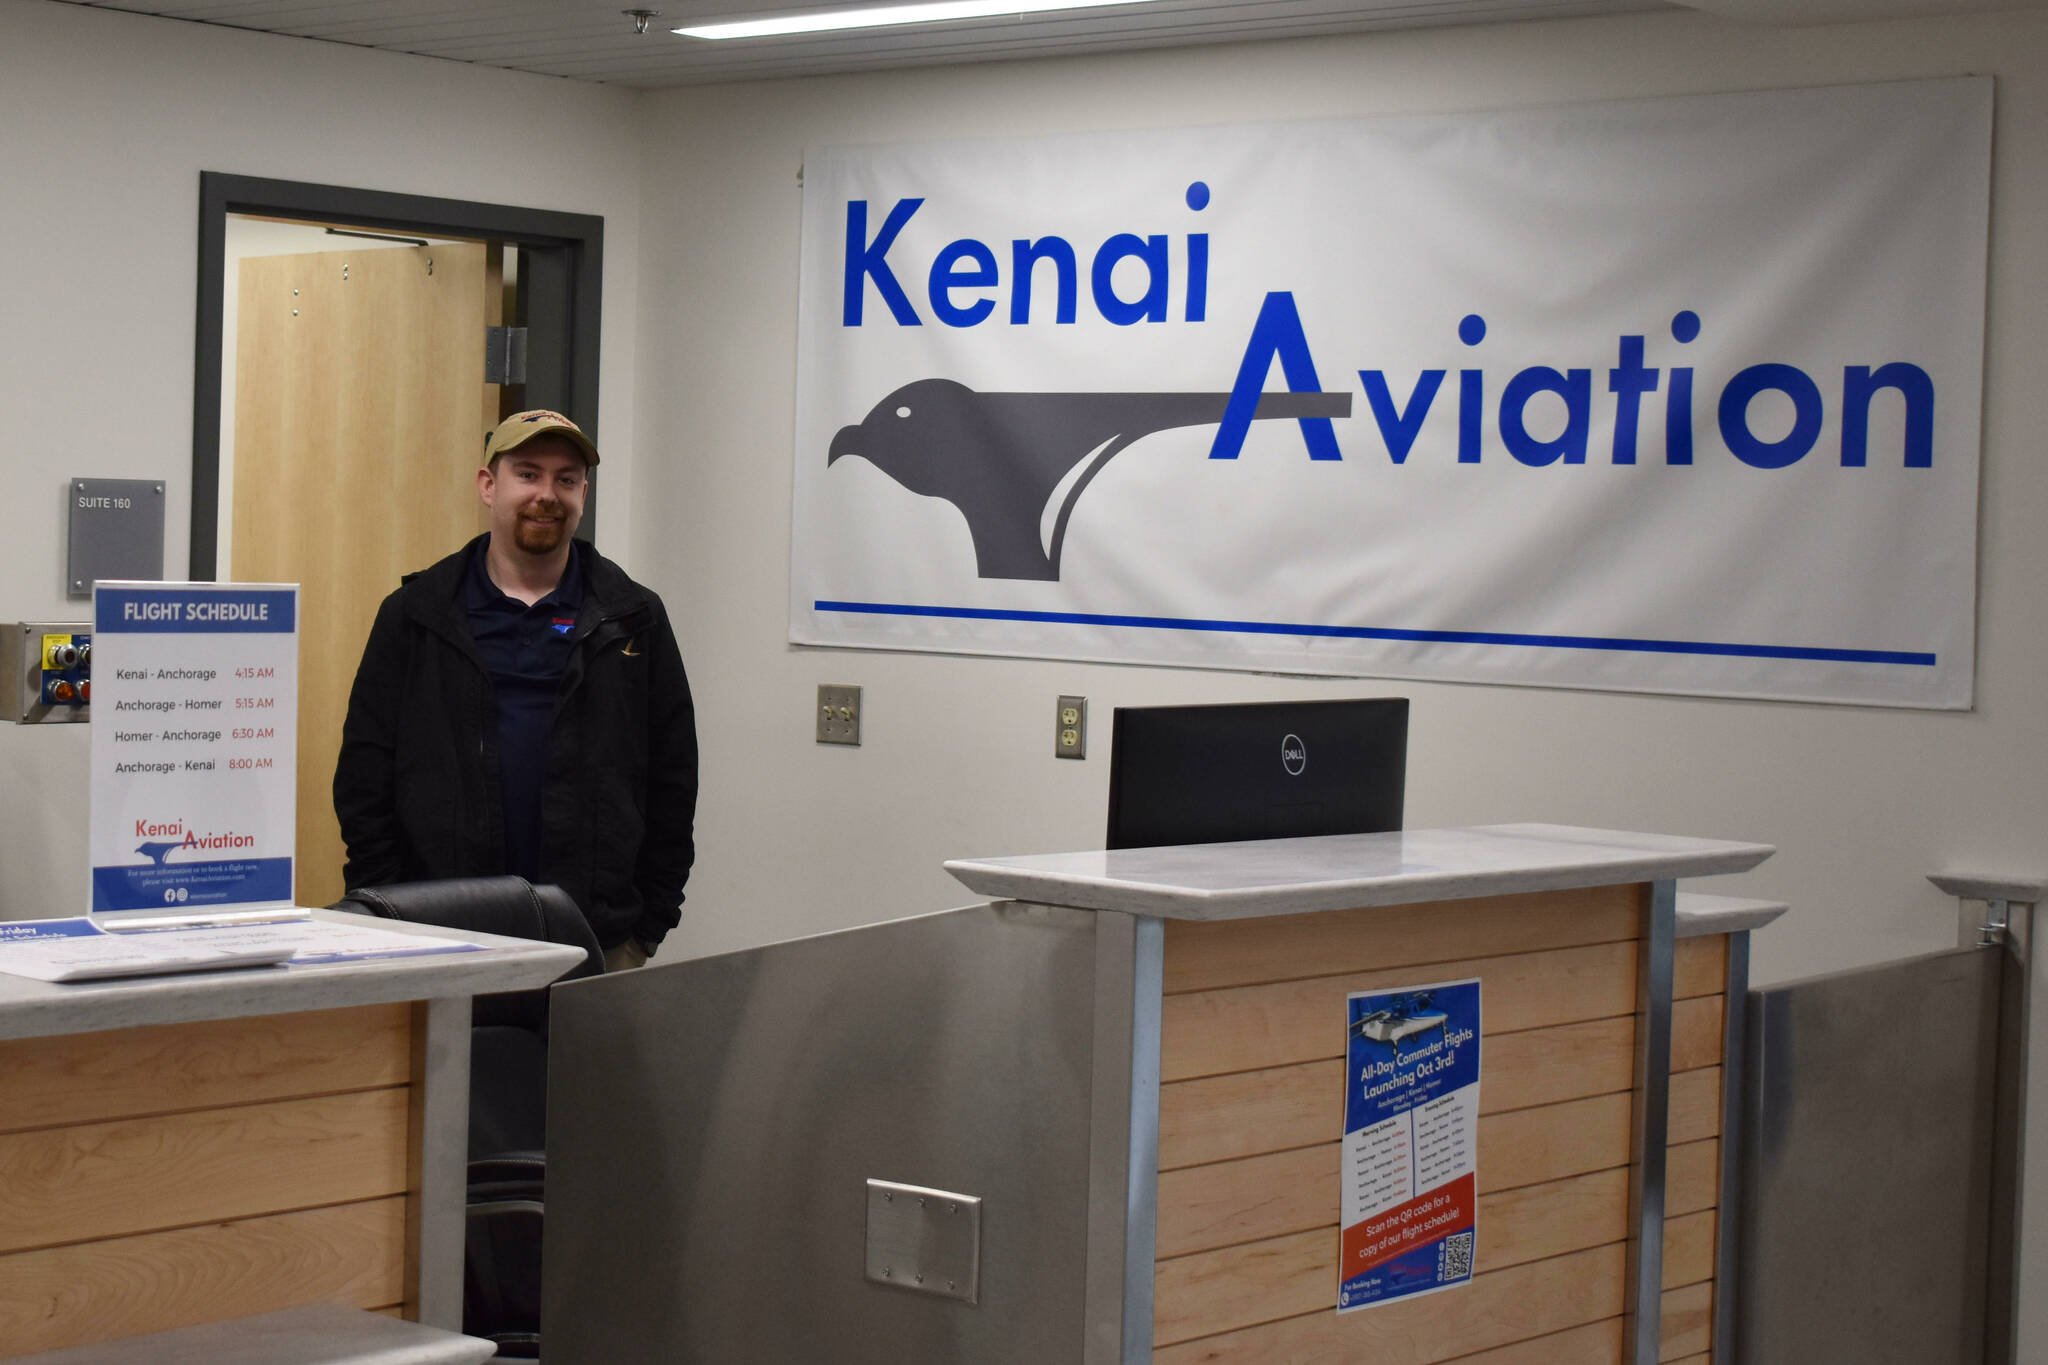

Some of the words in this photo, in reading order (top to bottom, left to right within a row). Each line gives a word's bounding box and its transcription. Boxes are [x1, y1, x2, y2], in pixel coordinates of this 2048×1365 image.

[842, 181, 1210, 328] Kenai
[1208, 291, 1937, 468] Aviation
[78, 497, 110, 509] SUITE
[113, 498, 131, 509] 160
[124, 603, 182, 620] FLIGHT
[185, 603, 268, 621] SCHEDULE
[116, 668, 148, 680] Kenai
[157, 668, 217, 681] Anchorage
[235, 668, 254, 679] 4:15
[257, 667, 274, 678] AM
[115, 700, 176, 712] Anchorage
[185, 699, 222, 709] Homer
[235, 698, 254, 709] 5:15
[257, 698, 274, 708] AM
[115, 731, 153, 741] Homer
[162, 730, 222, 742] Anchorage
[232, 728, 254, 739] 6:30
[256, 728, 274, 738] AM
[1285, 750, 1303, 760] DELL
[115, 762, 175, 774] Anchorage
[185, 759, 215, 771] Kenai
[229, 759, 253, 769] 8:00
[255, 758, 273, 769] AM
[136, 818, 183, 837] Kenai
[182, 830, 254, 850] Aviation
[1361, 1060, 1396, 1081] All-Day
[1396, 1041, 1443, 1067] Commuter
[1444, 1028, 1473, 1048] Flights
[1364, 1071, 1415, 1100] Launching
[1416, 1063, 1434, 1079] Oct
[1435, 1050, 1455, 1071] 3rd!
[1366, 1224, 1385, 1237] Scan
[1386, 1215, 1399, 1228] the
[1400, 1208, 1413, 1223] QR
[1413, 1202, 1433, 1216] code
[1433, 1196, 1444, 1207] for
[1445, 1195, 1451, 1203] a
[1359, 1243, 1378, 1259] copy
[1379, 1237, 1388, 1249] of
[1388, 1233, 1401, 1244] our
[1402, 1224, 1423, 1241] flight
[1424, 1208, 1459, 1231] schedule!
